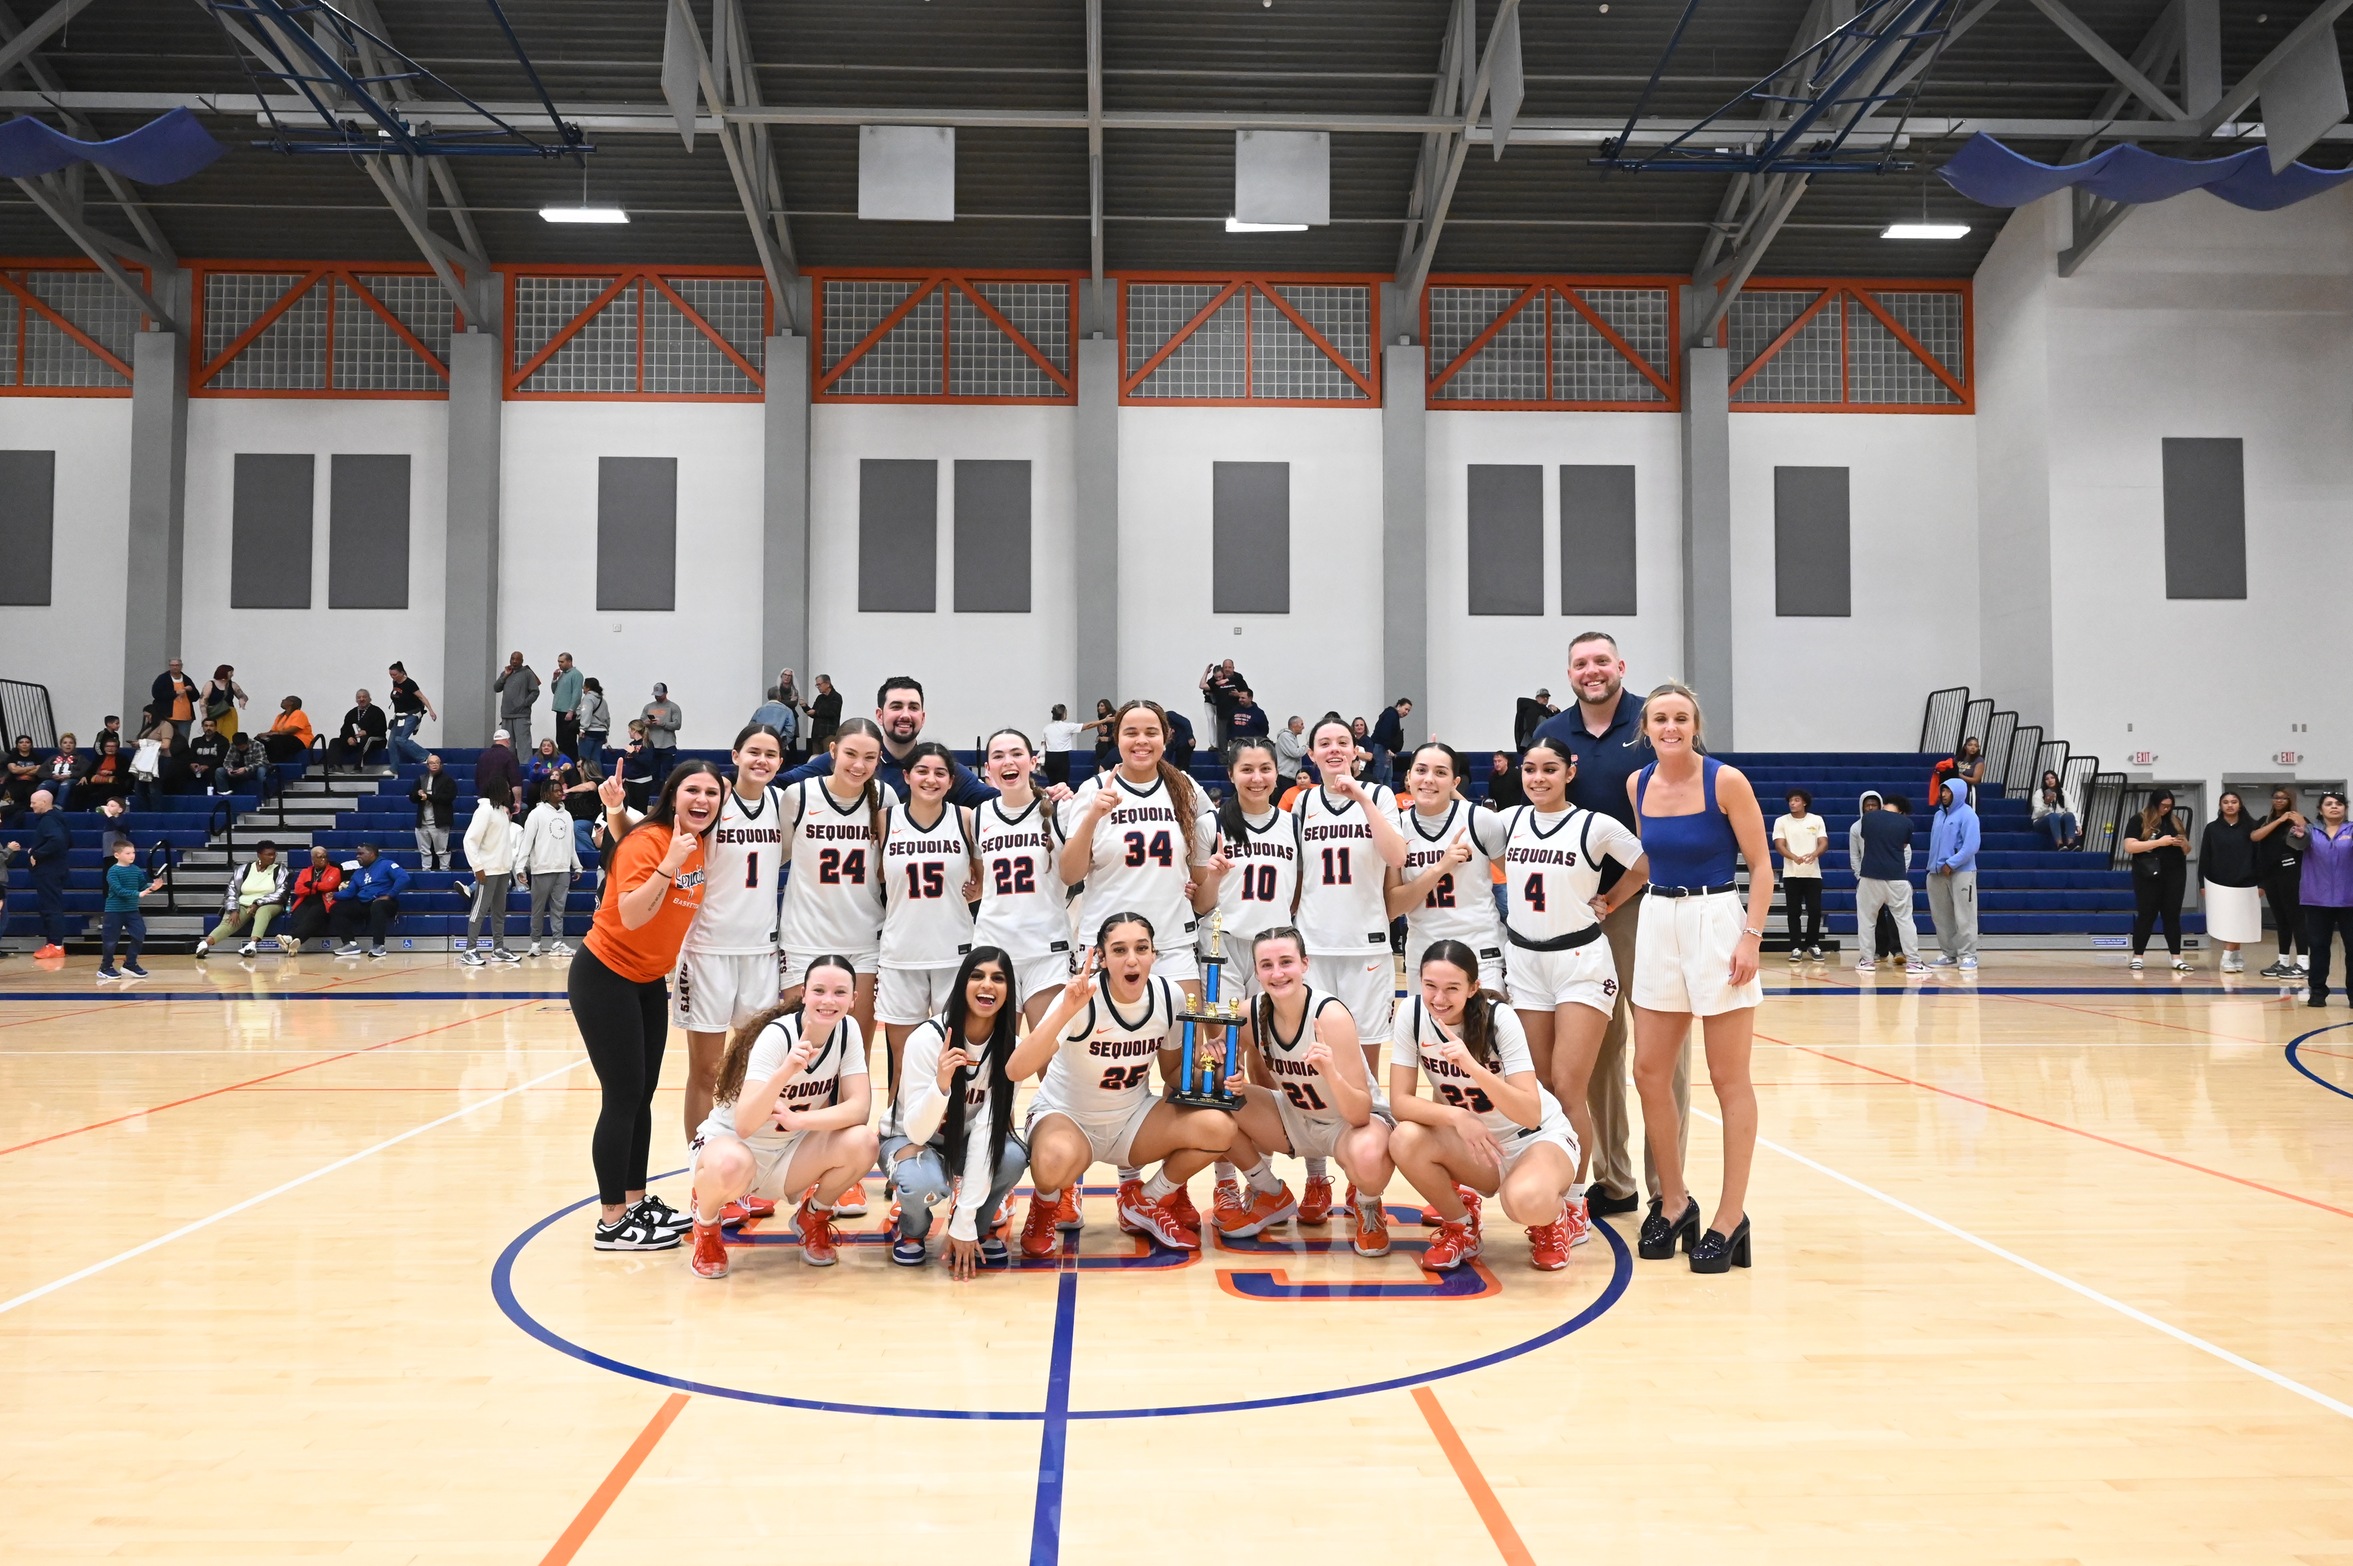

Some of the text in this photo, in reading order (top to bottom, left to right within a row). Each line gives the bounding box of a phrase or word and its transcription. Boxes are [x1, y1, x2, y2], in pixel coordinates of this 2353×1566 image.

[2136, 751, 2150, 763] EXIT
[2281, 751, 2295, 763] EXIT
[716, 829, 782, 845] SEQUOIAS
[806, 824, 872, 841] SEQUOIA
[981, 832, 1049, 853] SEQUOIAS
[1304, 823, 1372, 842] SEQUOIAS
[889, 839, 961, 856] SEQUOIAS
[1123, 830, 1173, 867] 34
[1224, 841, 1294, 861] SEQUOIAS
[1507, 847, 1577, 867] SEQUOIAS
[745, 851, 759, 889] 1
[820, 848, 866, 884] 24
[906, 861, 945, 899] 15
[992, 856, 1036, 895] 22
[1321, 847, 1352, 885] 11
[1241, 863, 1277, 902] 10
[1524, 872, 1546, 912] 4
[679, 962, 690, 1013] GIANTS
[1088, 1036, 1165, 1059] SEQUOIAS
[1098, 1063, 1150, 1091] 25
[1272, 1058, 1320, 1076] QUOIA
[1281, 1081, 1328, 1111] 21
[1439, 1083, 1495, 1114] 23
